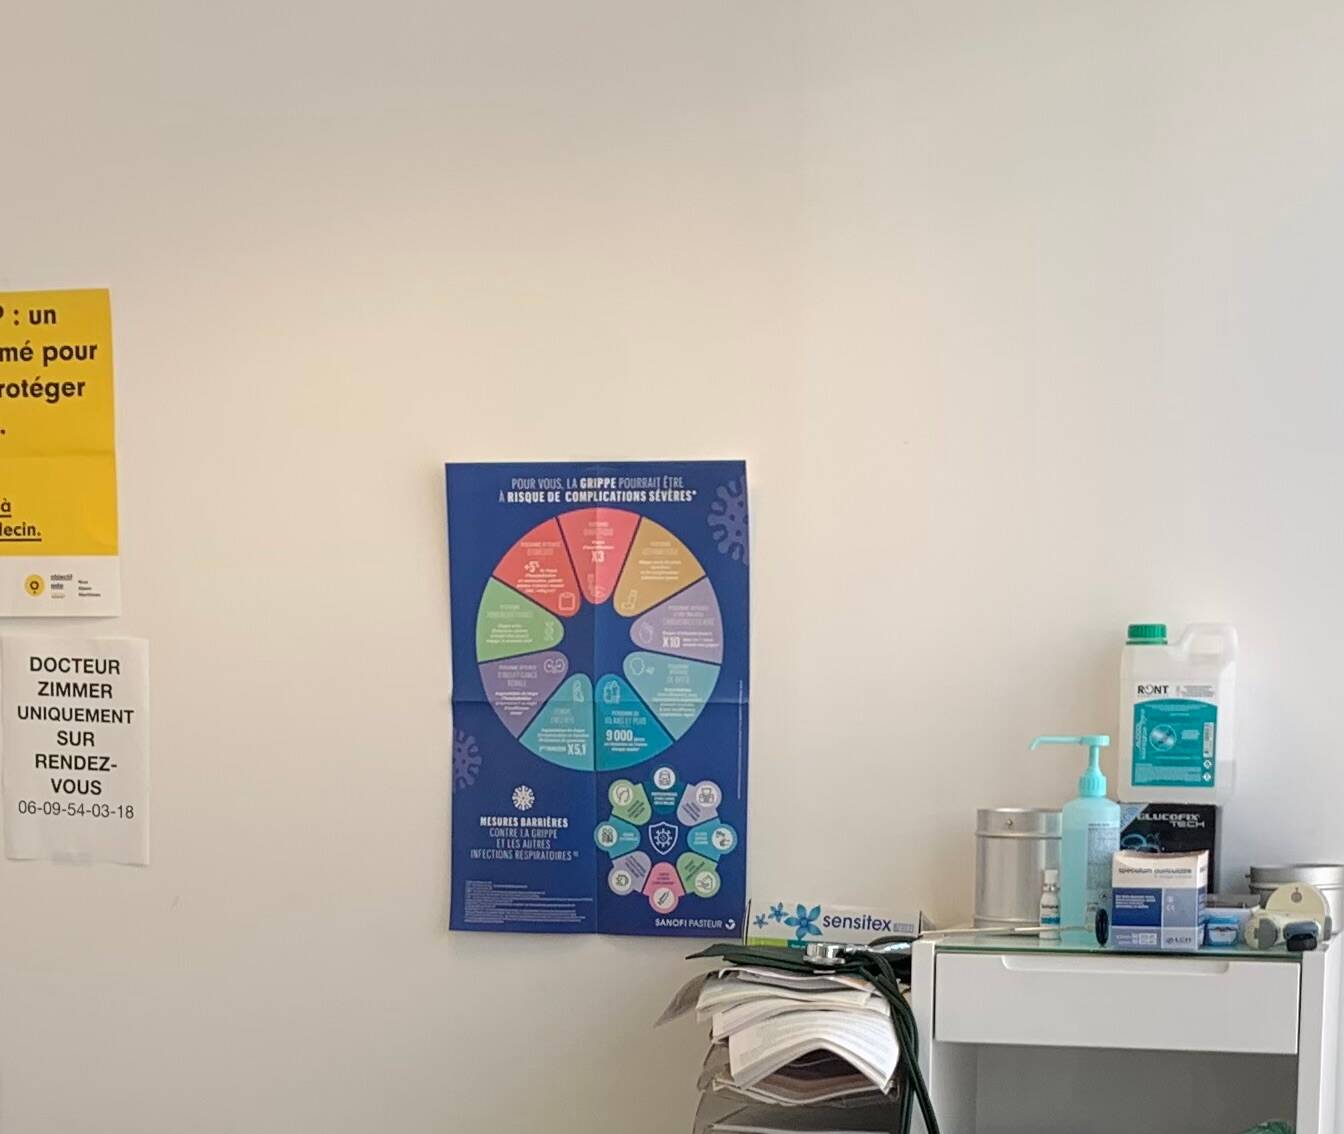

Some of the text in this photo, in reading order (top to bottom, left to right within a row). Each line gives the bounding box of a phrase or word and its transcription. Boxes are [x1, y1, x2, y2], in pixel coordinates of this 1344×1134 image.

[29, 309, 56, 324] un
[43, 344, 97, 367] pour
[512, 478, 536, 489] POUR
[567, 478, 578, 489] LA
[580, 477, 616, 489] GRIPPE
[619, 477, 660, 489] POURRAIT
[663, 475, 684, 489] ÊTRE
[507, 491, 545, 503] RISQUE
[547, 491, 561, 503] DE
[565, 490, 645, 503] COMPLICATIONS
[1, 498, 11, 513] à
[29, 656, 121, 675] DOCTEUR
[38, 681, 113, 699] ZIMMER
[18, 706, 134, 724] UNIQUEMENT
[56, 731, 95, 746] SUR
[35, 754, 117, 772] RENDEZ-
[51, 778, 102, 795] VOUS
[18, 800, 134, 819] 06-09-54-03-18
[1137, 812, 1201, 821] GLUCOFIX
[480, 815, 568, 828] MESURES BARRIÈRES
[1170, 820, 1205, 828] TECH
[489, 828, 558, 839] CONTRE LA GRIPPE
[496, 839, 551, 849] ET LES AUTRES
[470, 849, 513, 859] INFECTIONS
[656, 918, 723, 929] SANOFI PASTEUR
[822, 914, 892, 932] sensitex
